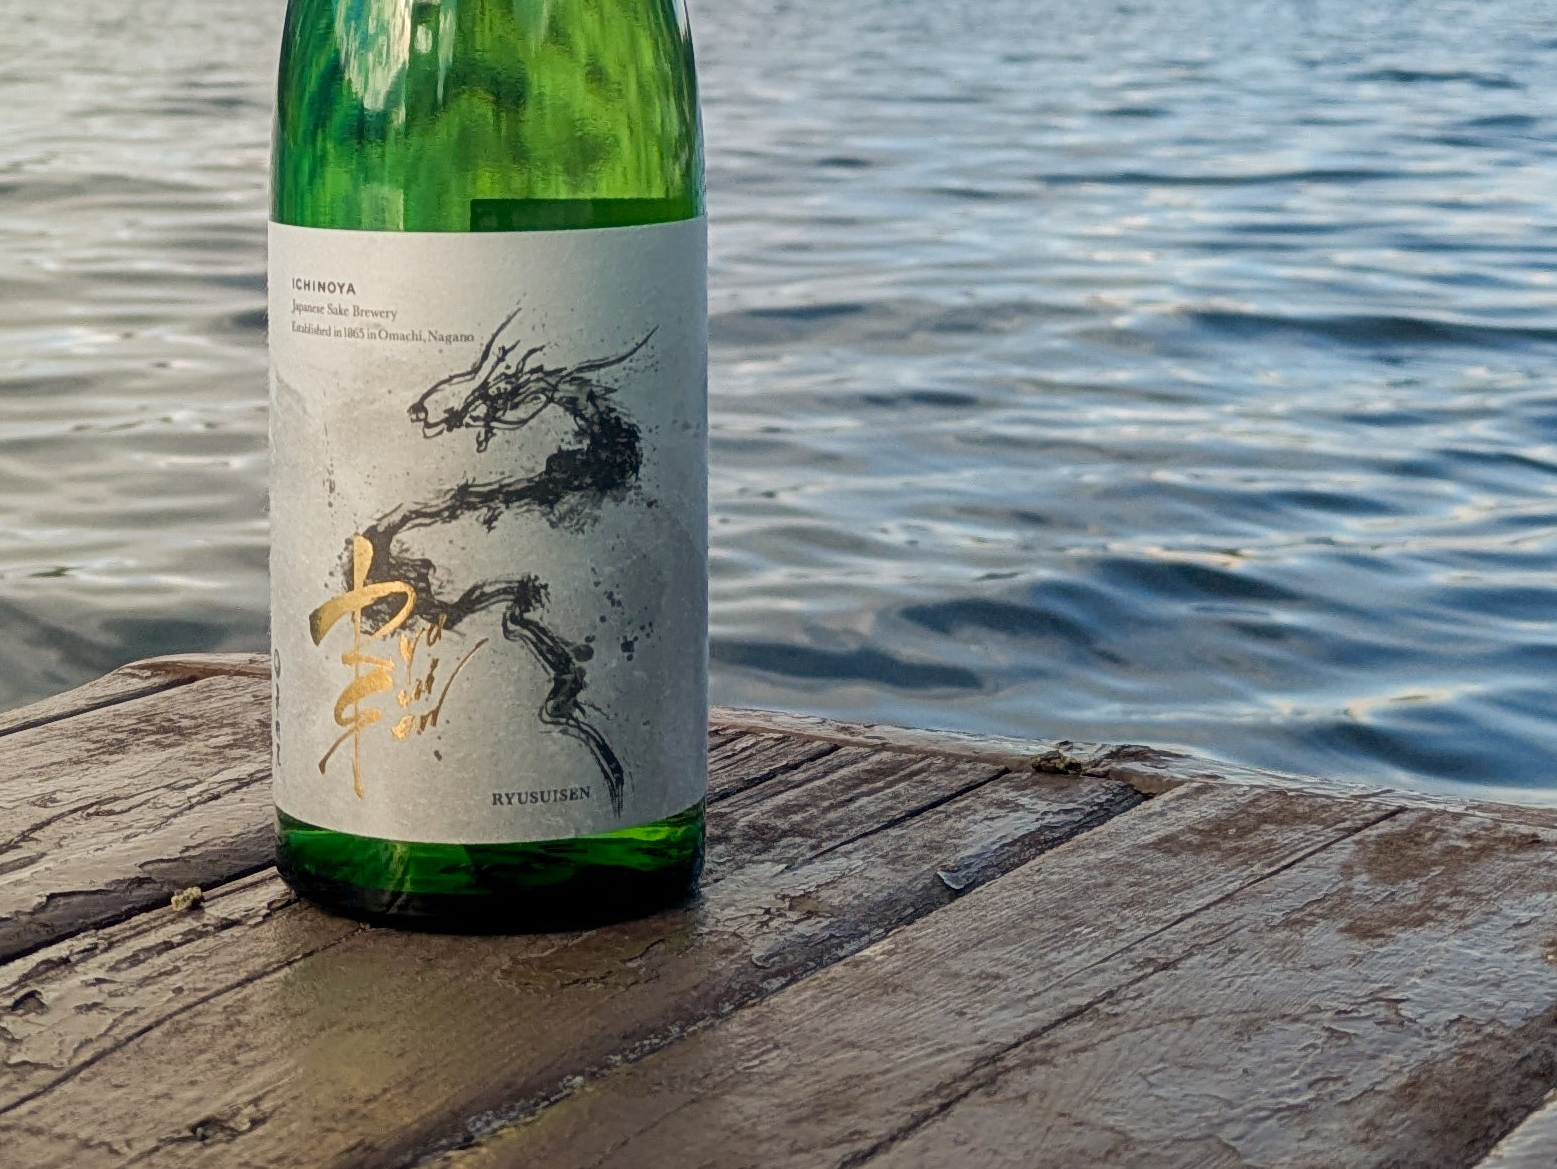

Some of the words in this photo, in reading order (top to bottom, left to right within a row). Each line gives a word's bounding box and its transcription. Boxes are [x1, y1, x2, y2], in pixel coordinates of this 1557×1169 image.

[292, 277, 356, 295] ICHINOYA
[291, 298, 325, 316] Japanese
[327, 303, 349, 317] Sake
[352, 304, 398, 321] Brewery
[291, 321, 332, 338] Established
[333, 327, 342, 338] in
[343, 326, 365, 339] 1865
[367, 328, 377, 340] in
[378, 328, 426, 343] Omachi,
[428, 330, 475, 344] Nagano
[491, 785, 591, 806] RYUSUISEN
